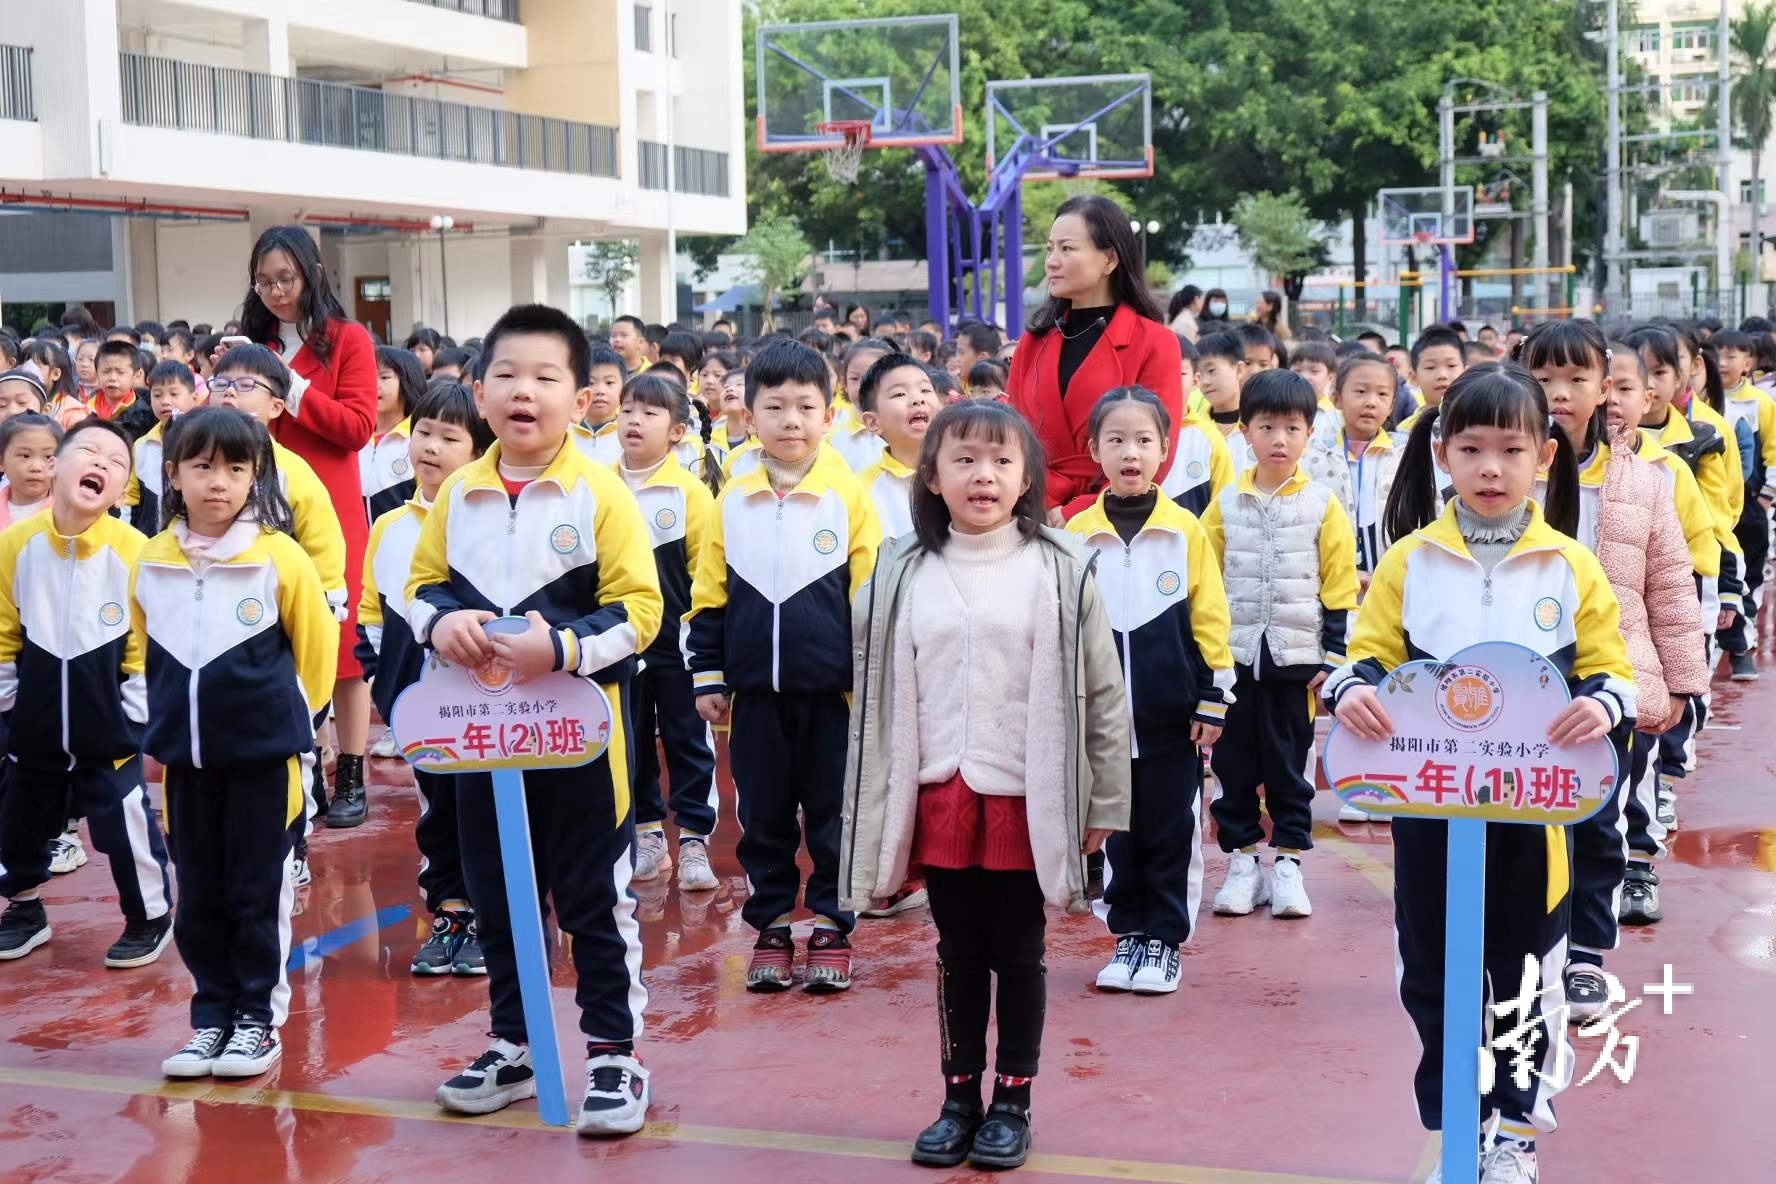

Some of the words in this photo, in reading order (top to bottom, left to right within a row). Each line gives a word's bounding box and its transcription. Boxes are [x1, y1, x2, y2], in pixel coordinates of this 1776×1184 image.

[438, 699, 559, 719] 揭阳市第二实验小学
[423, 717, 585, 759] 一年(2)班
[1389, 736, 1550, 758] 揭阳市第二实验小学
[1364, 760, 1577, 809] 一年(1)班
